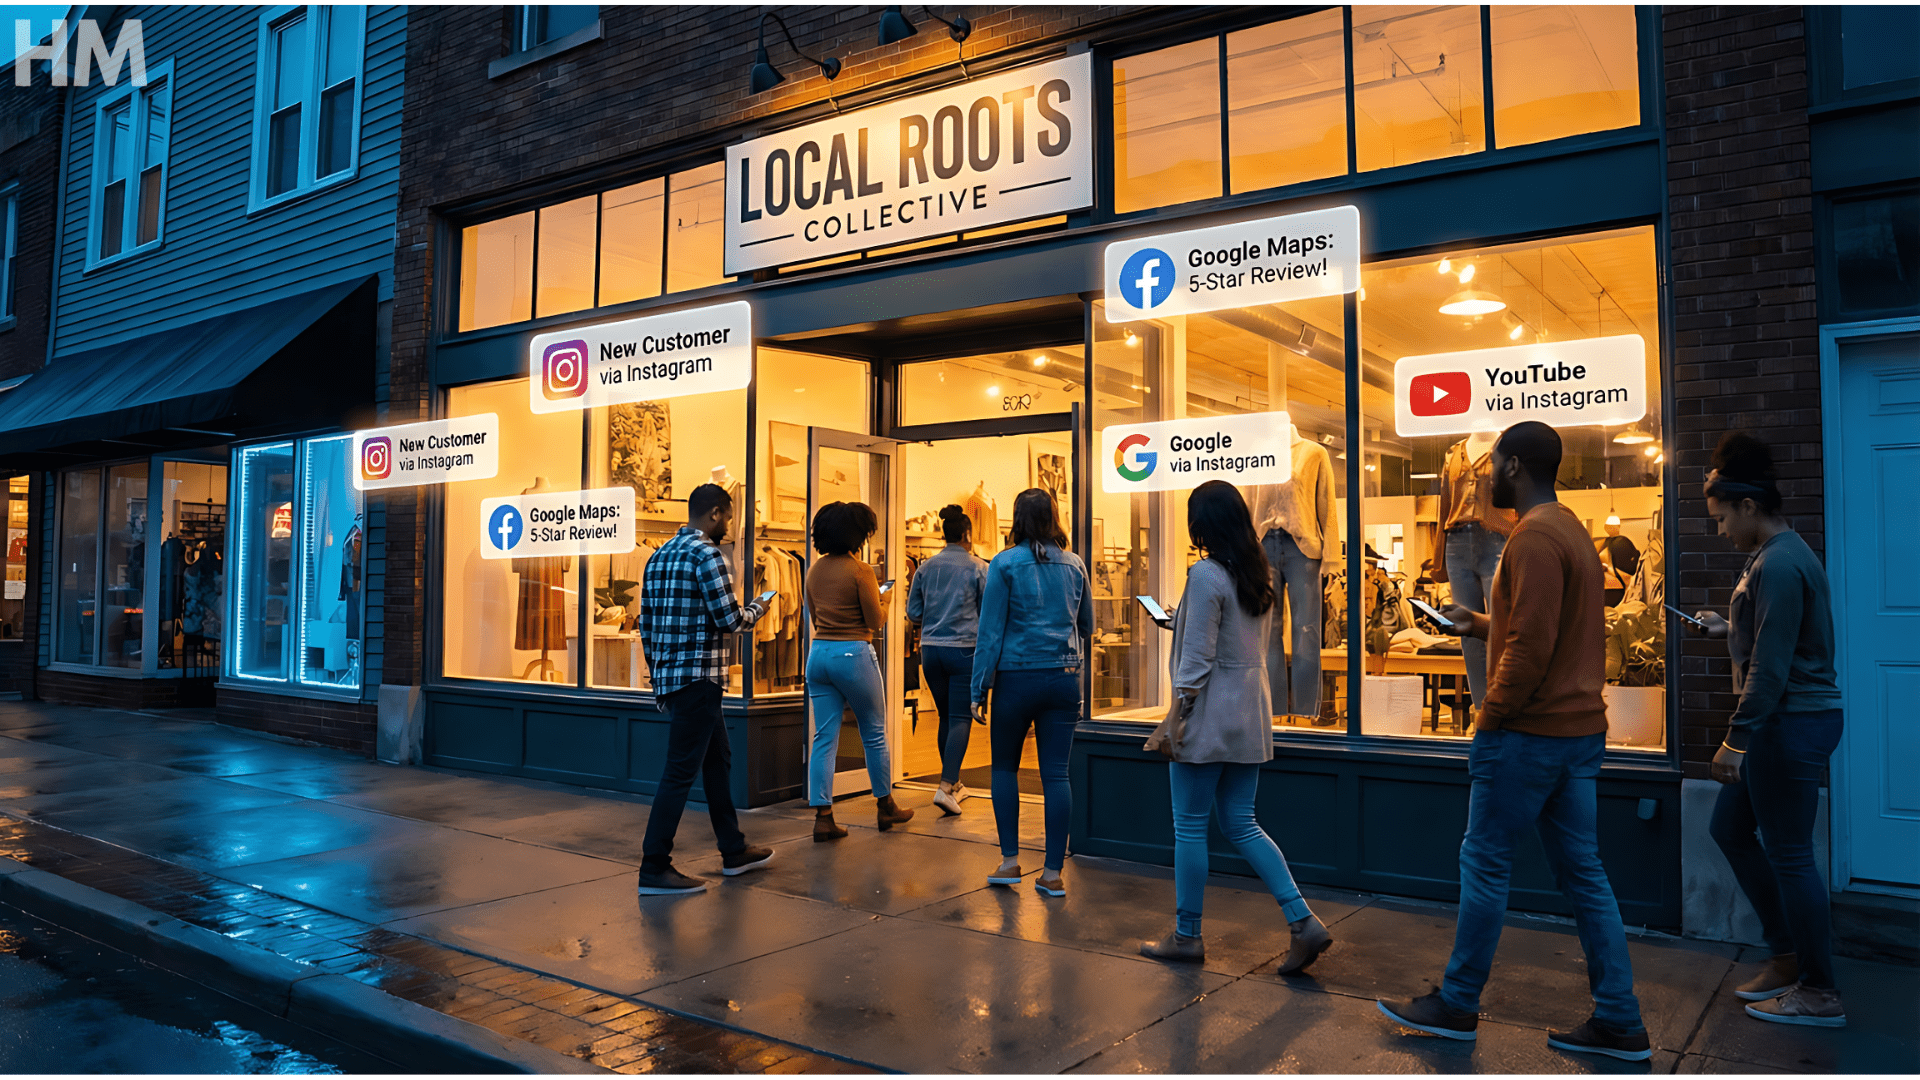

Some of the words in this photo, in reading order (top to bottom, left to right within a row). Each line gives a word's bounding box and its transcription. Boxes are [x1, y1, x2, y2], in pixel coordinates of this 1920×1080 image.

[741, 128, 883, 223] LOCAL
[899, 79, 1071, 189] ROOTS
[804, 185, 987, 242] COLLECTIVE
